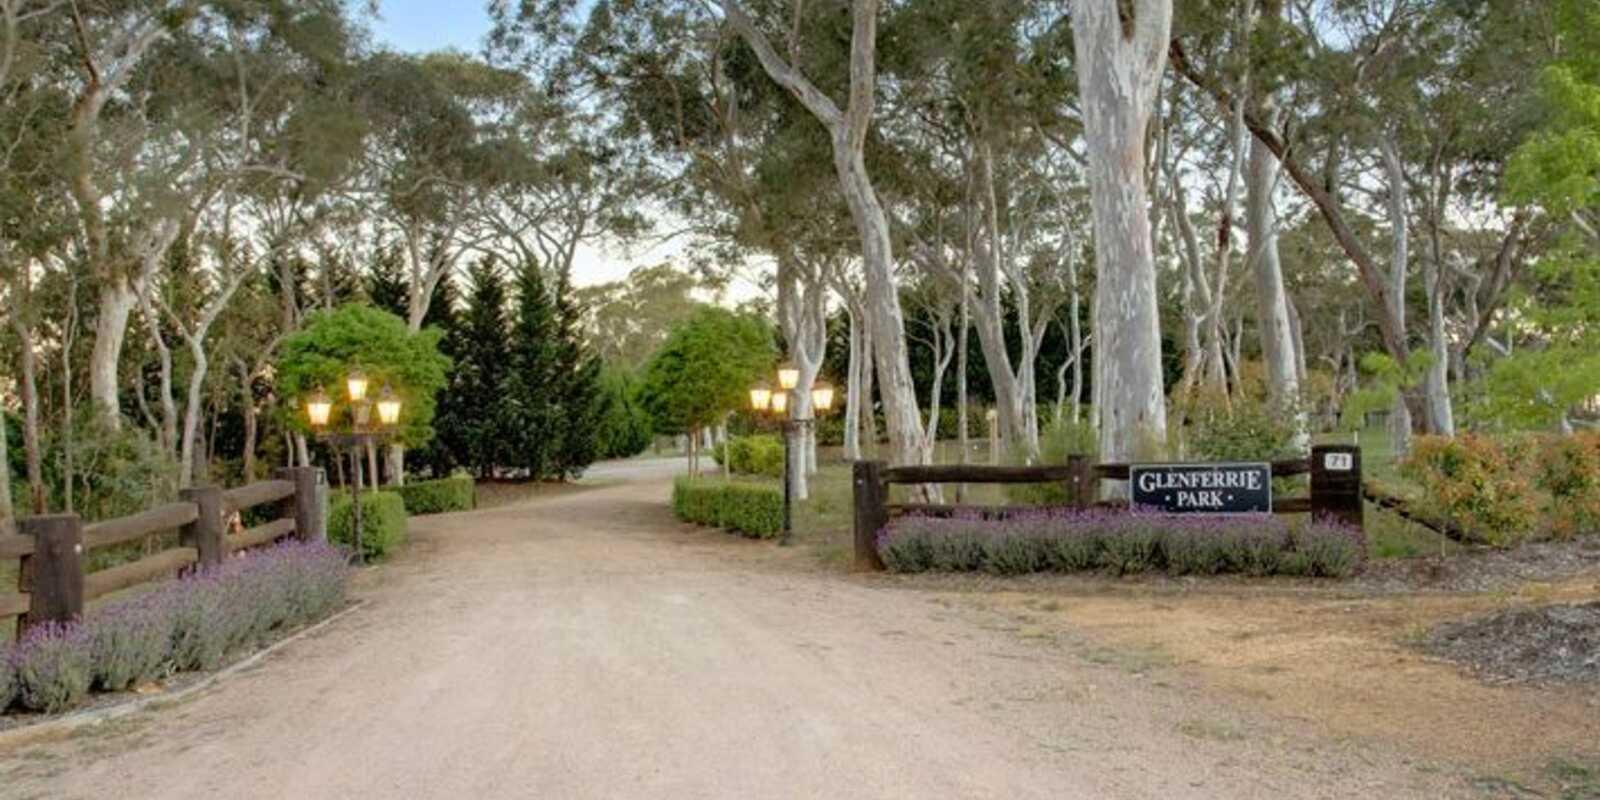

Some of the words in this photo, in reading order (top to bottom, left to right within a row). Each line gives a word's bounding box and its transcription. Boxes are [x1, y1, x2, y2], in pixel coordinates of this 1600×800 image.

[1329, 455, 1347, 467] 71
[1139, 470, 1261, 492] GLENFERRIE
[1177, 491, 1224, 507] PARK
